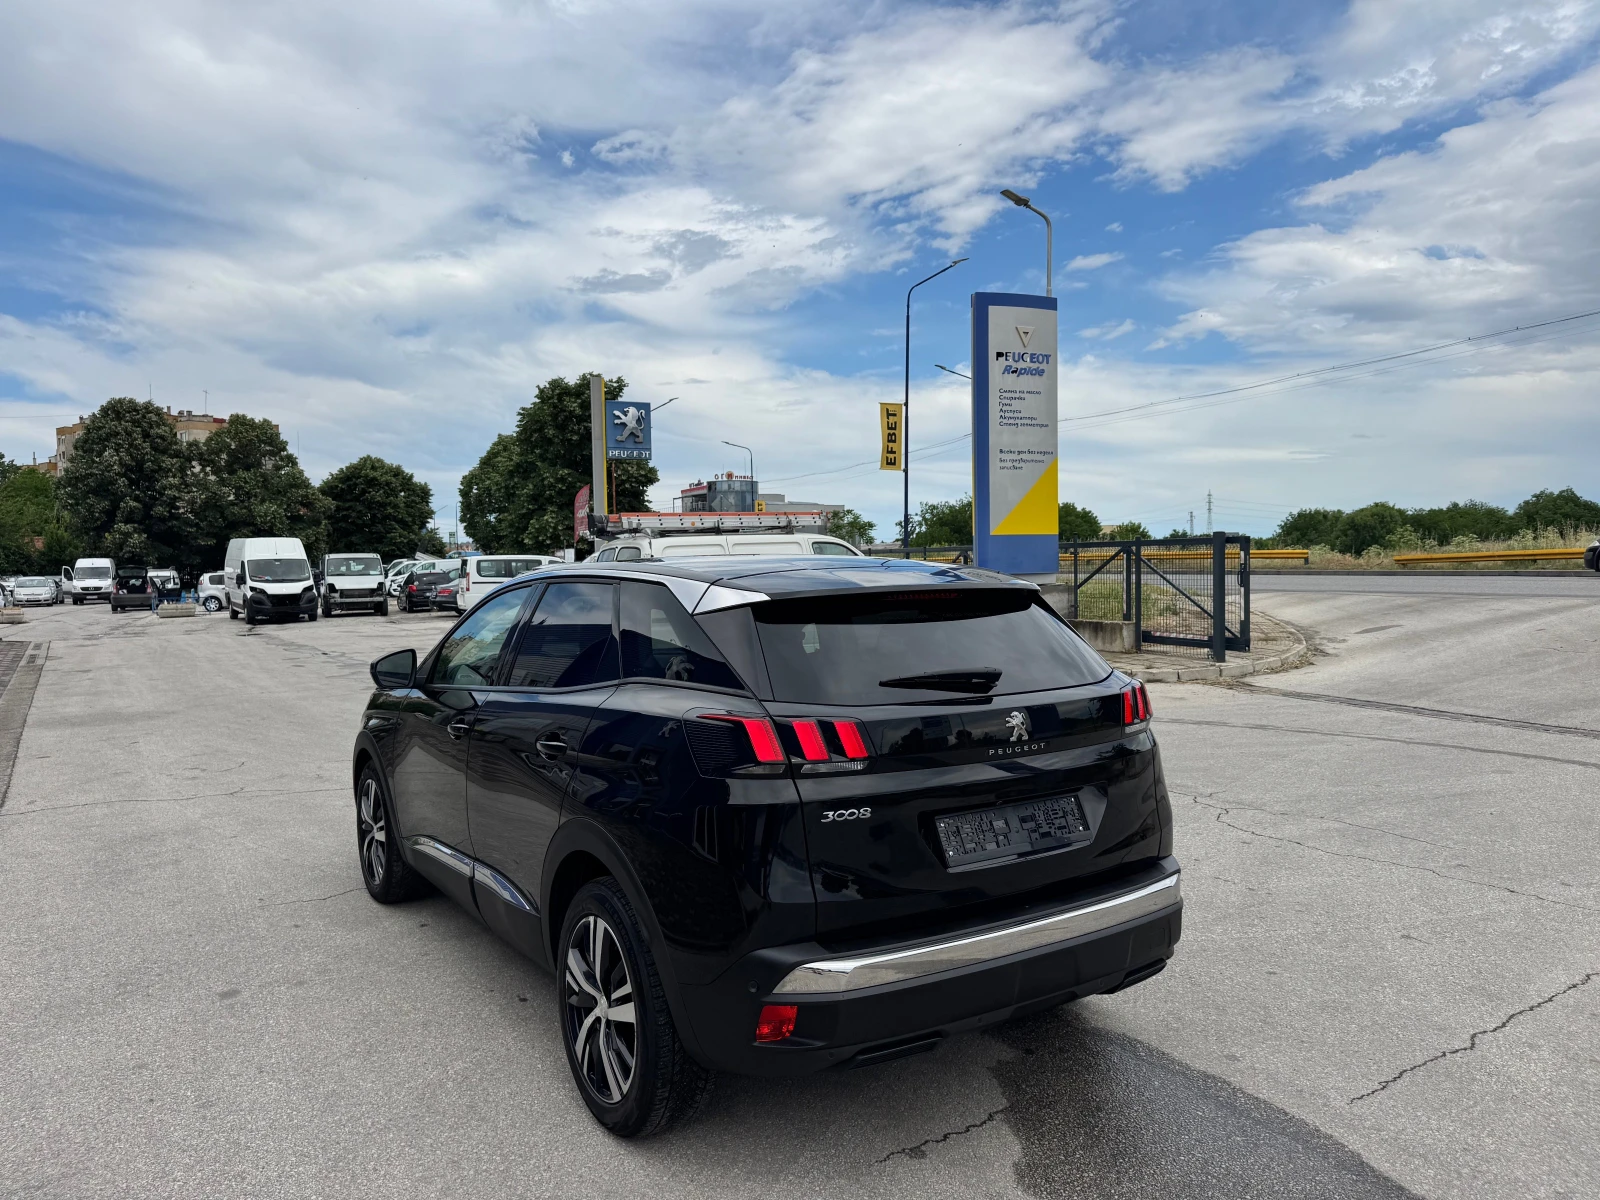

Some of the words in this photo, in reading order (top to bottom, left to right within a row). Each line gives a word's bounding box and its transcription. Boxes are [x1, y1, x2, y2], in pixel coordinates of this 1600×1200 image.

[1002, 365, 1045, 377] Rapide
[886, 407, 897, 466] EFBET
[609, 450, 650, 458] PEUGEOT
[989, 742, 1045, 756] PEUGEOT
[821, 807, 871, 822] 3008
